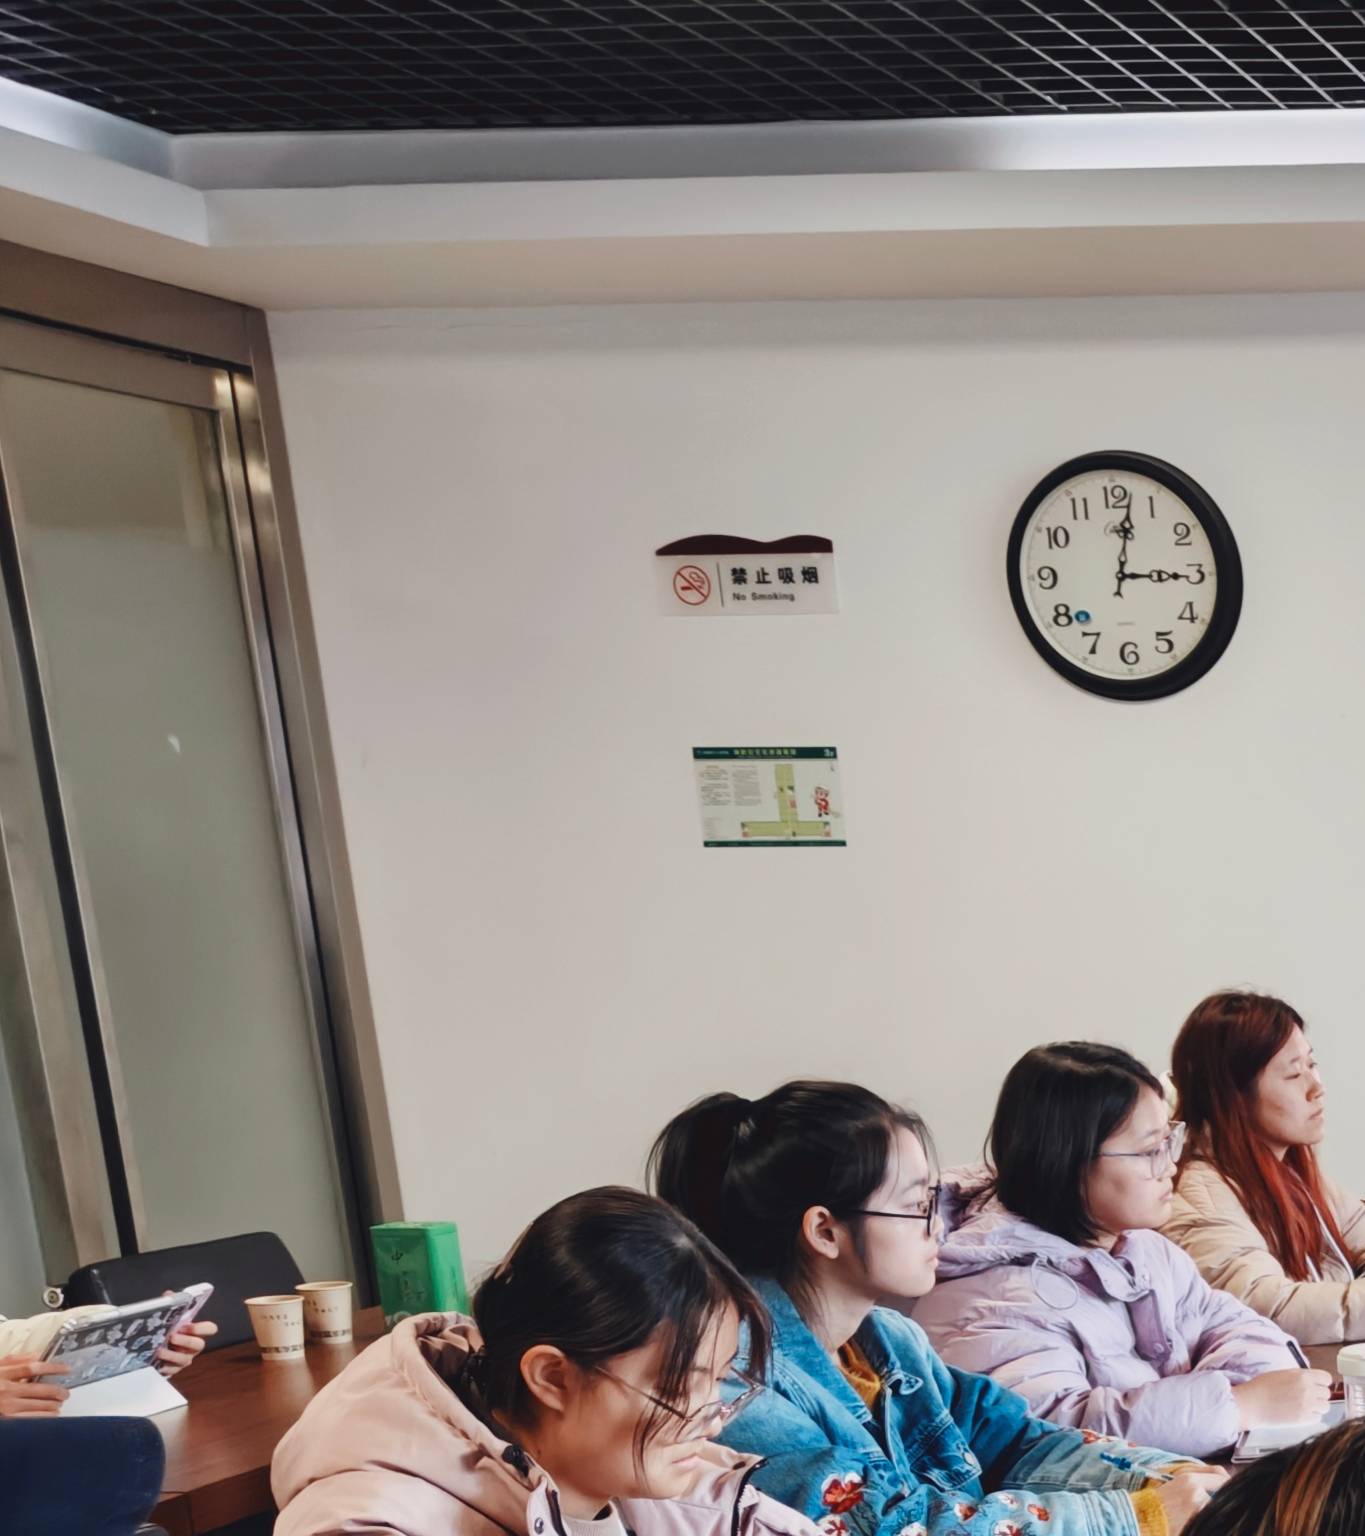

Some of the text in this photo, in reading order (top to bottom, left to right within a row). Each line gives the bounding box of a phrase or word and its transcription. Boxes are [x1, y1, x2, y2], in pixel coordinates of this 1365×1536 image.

[1070, 497, 1090, 521] 11
[1102, 484, 1128, 510] 12
[1148, 495, 1156, 519] 1
[1046, 525, 1070, 550] 10
[1173, 522, 1192, 546] 2
[730, 566, 820, 586] 禁止吸烟
[1036, 565, 1058, 590] 9
[1184, 563, 1206, 585] 3
[732, 591, 796, 603] No Smoking
[1052, 603, 1074, 628] 8
[1177, 601, 1199, 624] 4
[1081, 630, 1102, 655] 7
[1119, 641, 1140, 666] 6
[1154, 630, 1175, 654] 5
